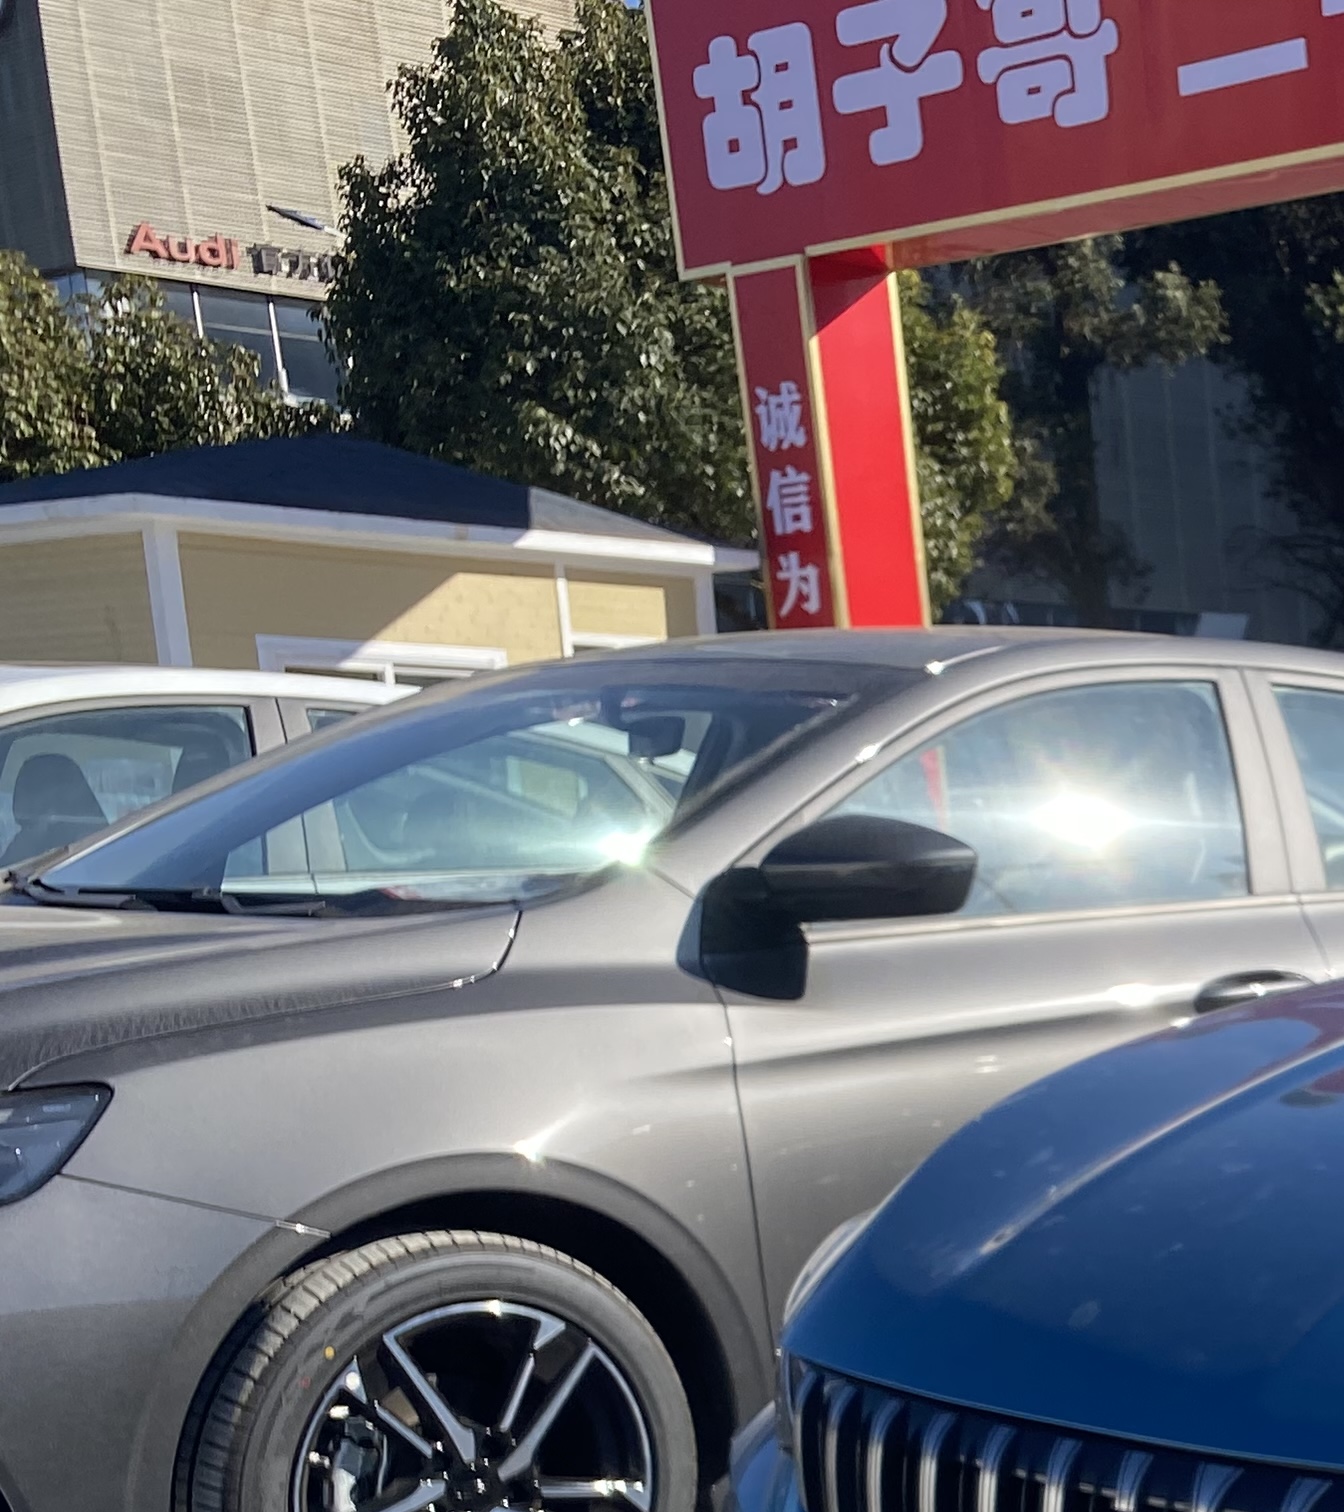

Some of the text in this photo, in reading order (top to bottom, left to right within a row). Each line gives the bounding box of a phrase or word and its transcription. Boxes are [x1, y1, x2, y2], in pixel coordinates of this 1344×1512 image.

[126, 220, 240, 270] Audi
[754, 380, 822, 618] 诚信为
